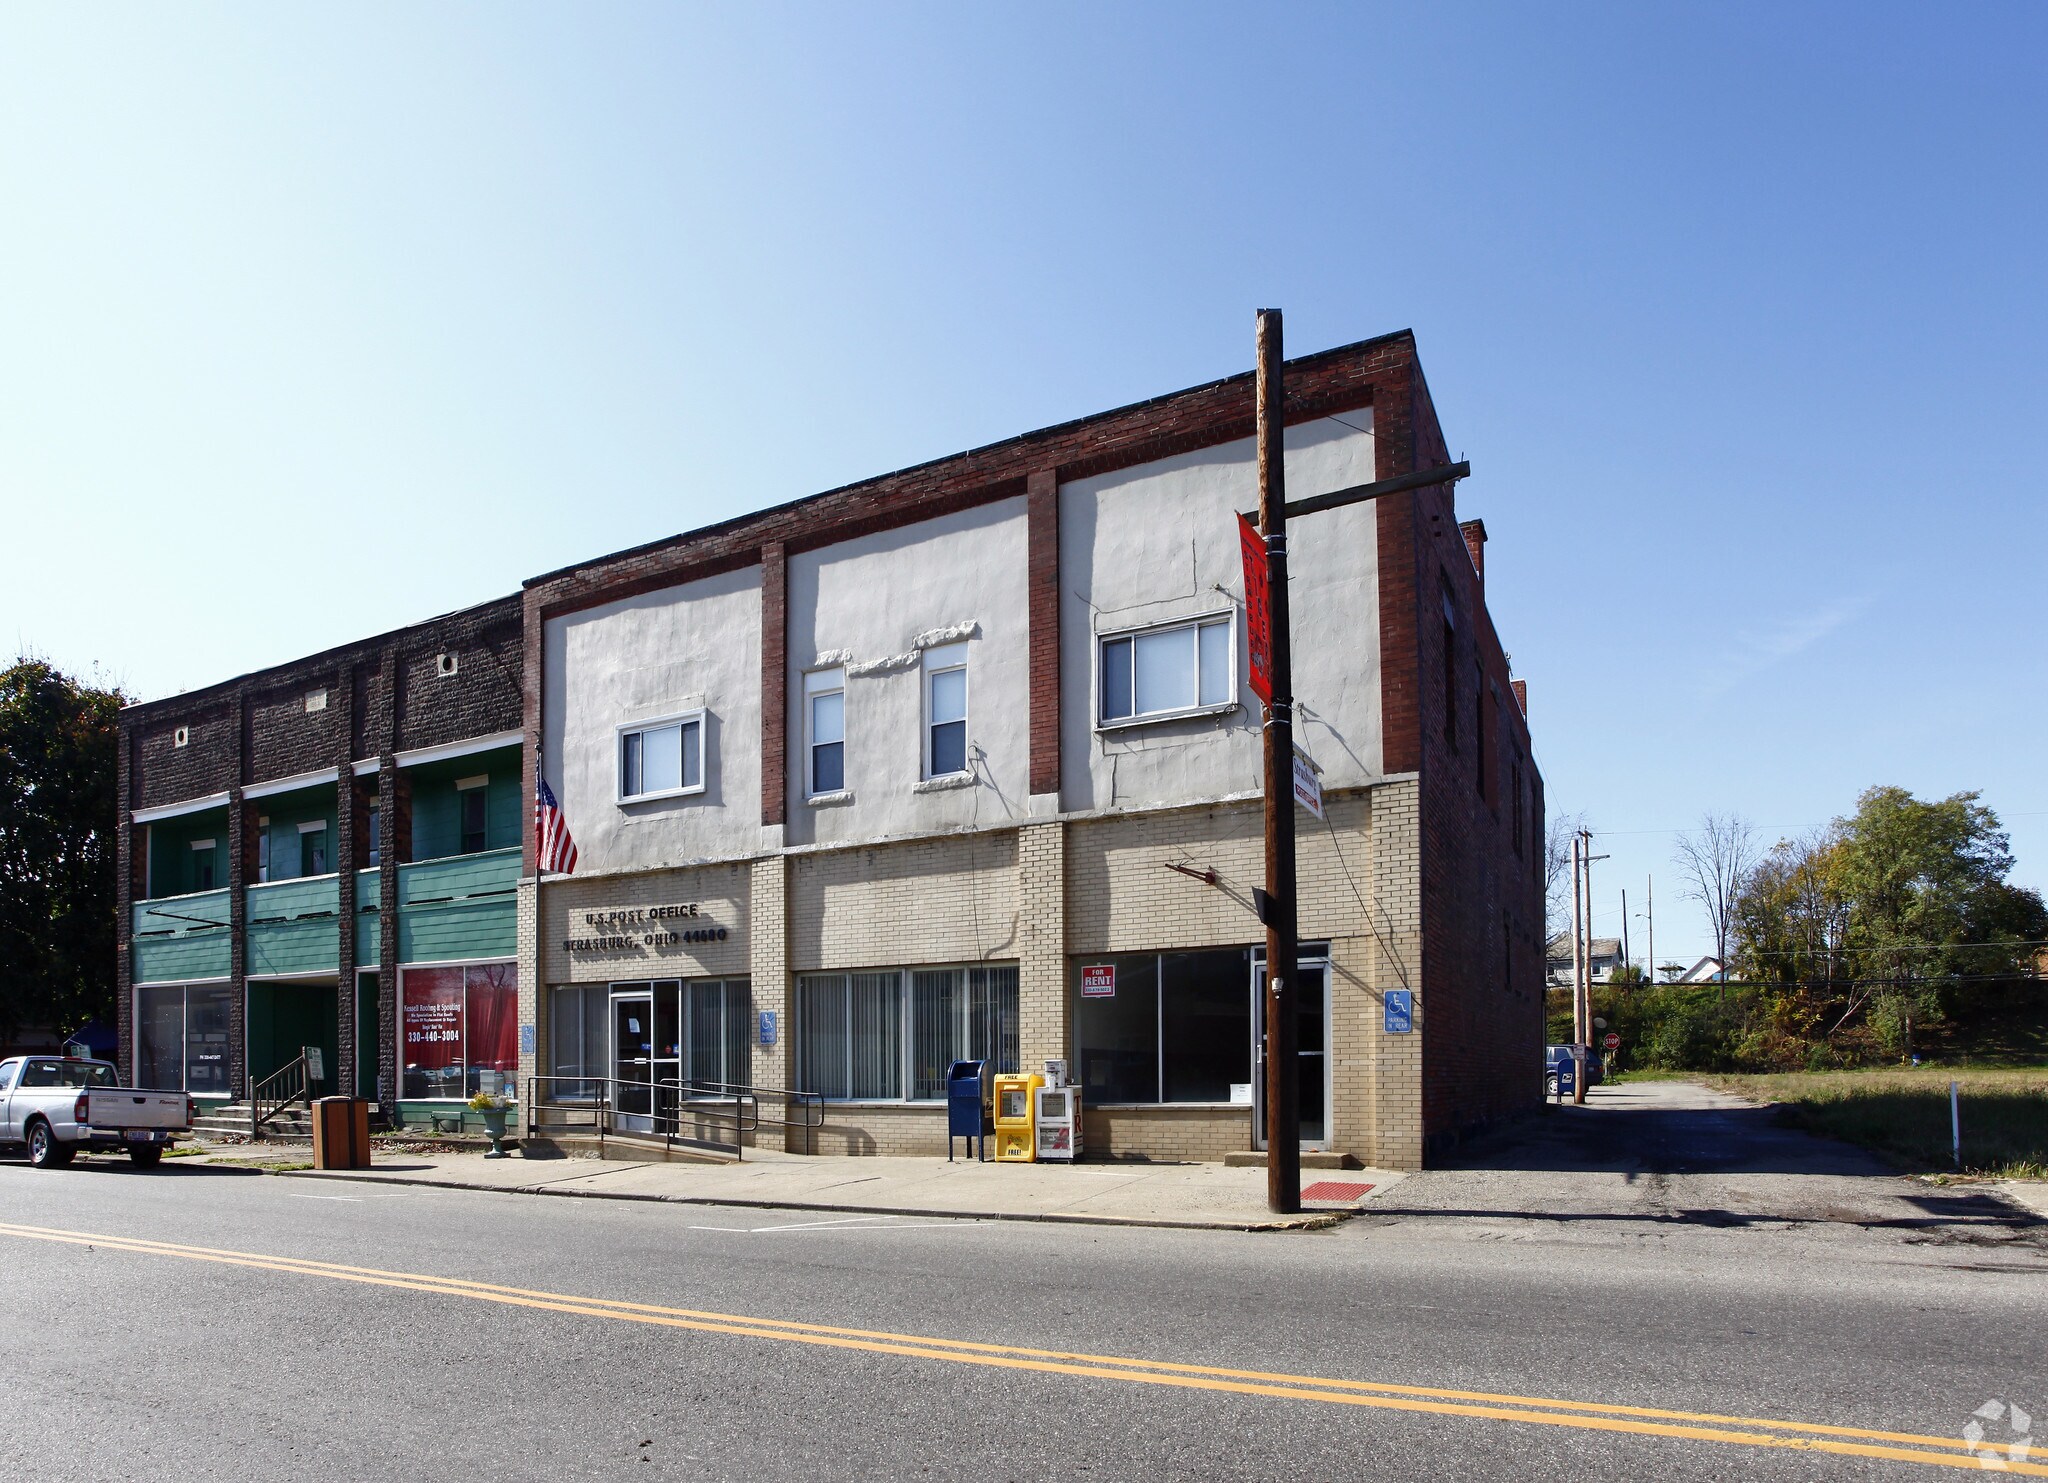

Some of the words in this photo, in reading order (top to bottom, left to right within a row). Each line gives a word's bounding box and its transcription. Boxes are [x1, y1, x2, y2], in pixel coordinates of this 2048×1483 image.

[649, 903, 698, 920] OFFICE
[643, 932, 679, 946] OHIO
[683, 928, 727, 944] 44680
[1085, 975, 1111, 986] RENT
[408, 1030, 459, 1042] 330-440-3004
